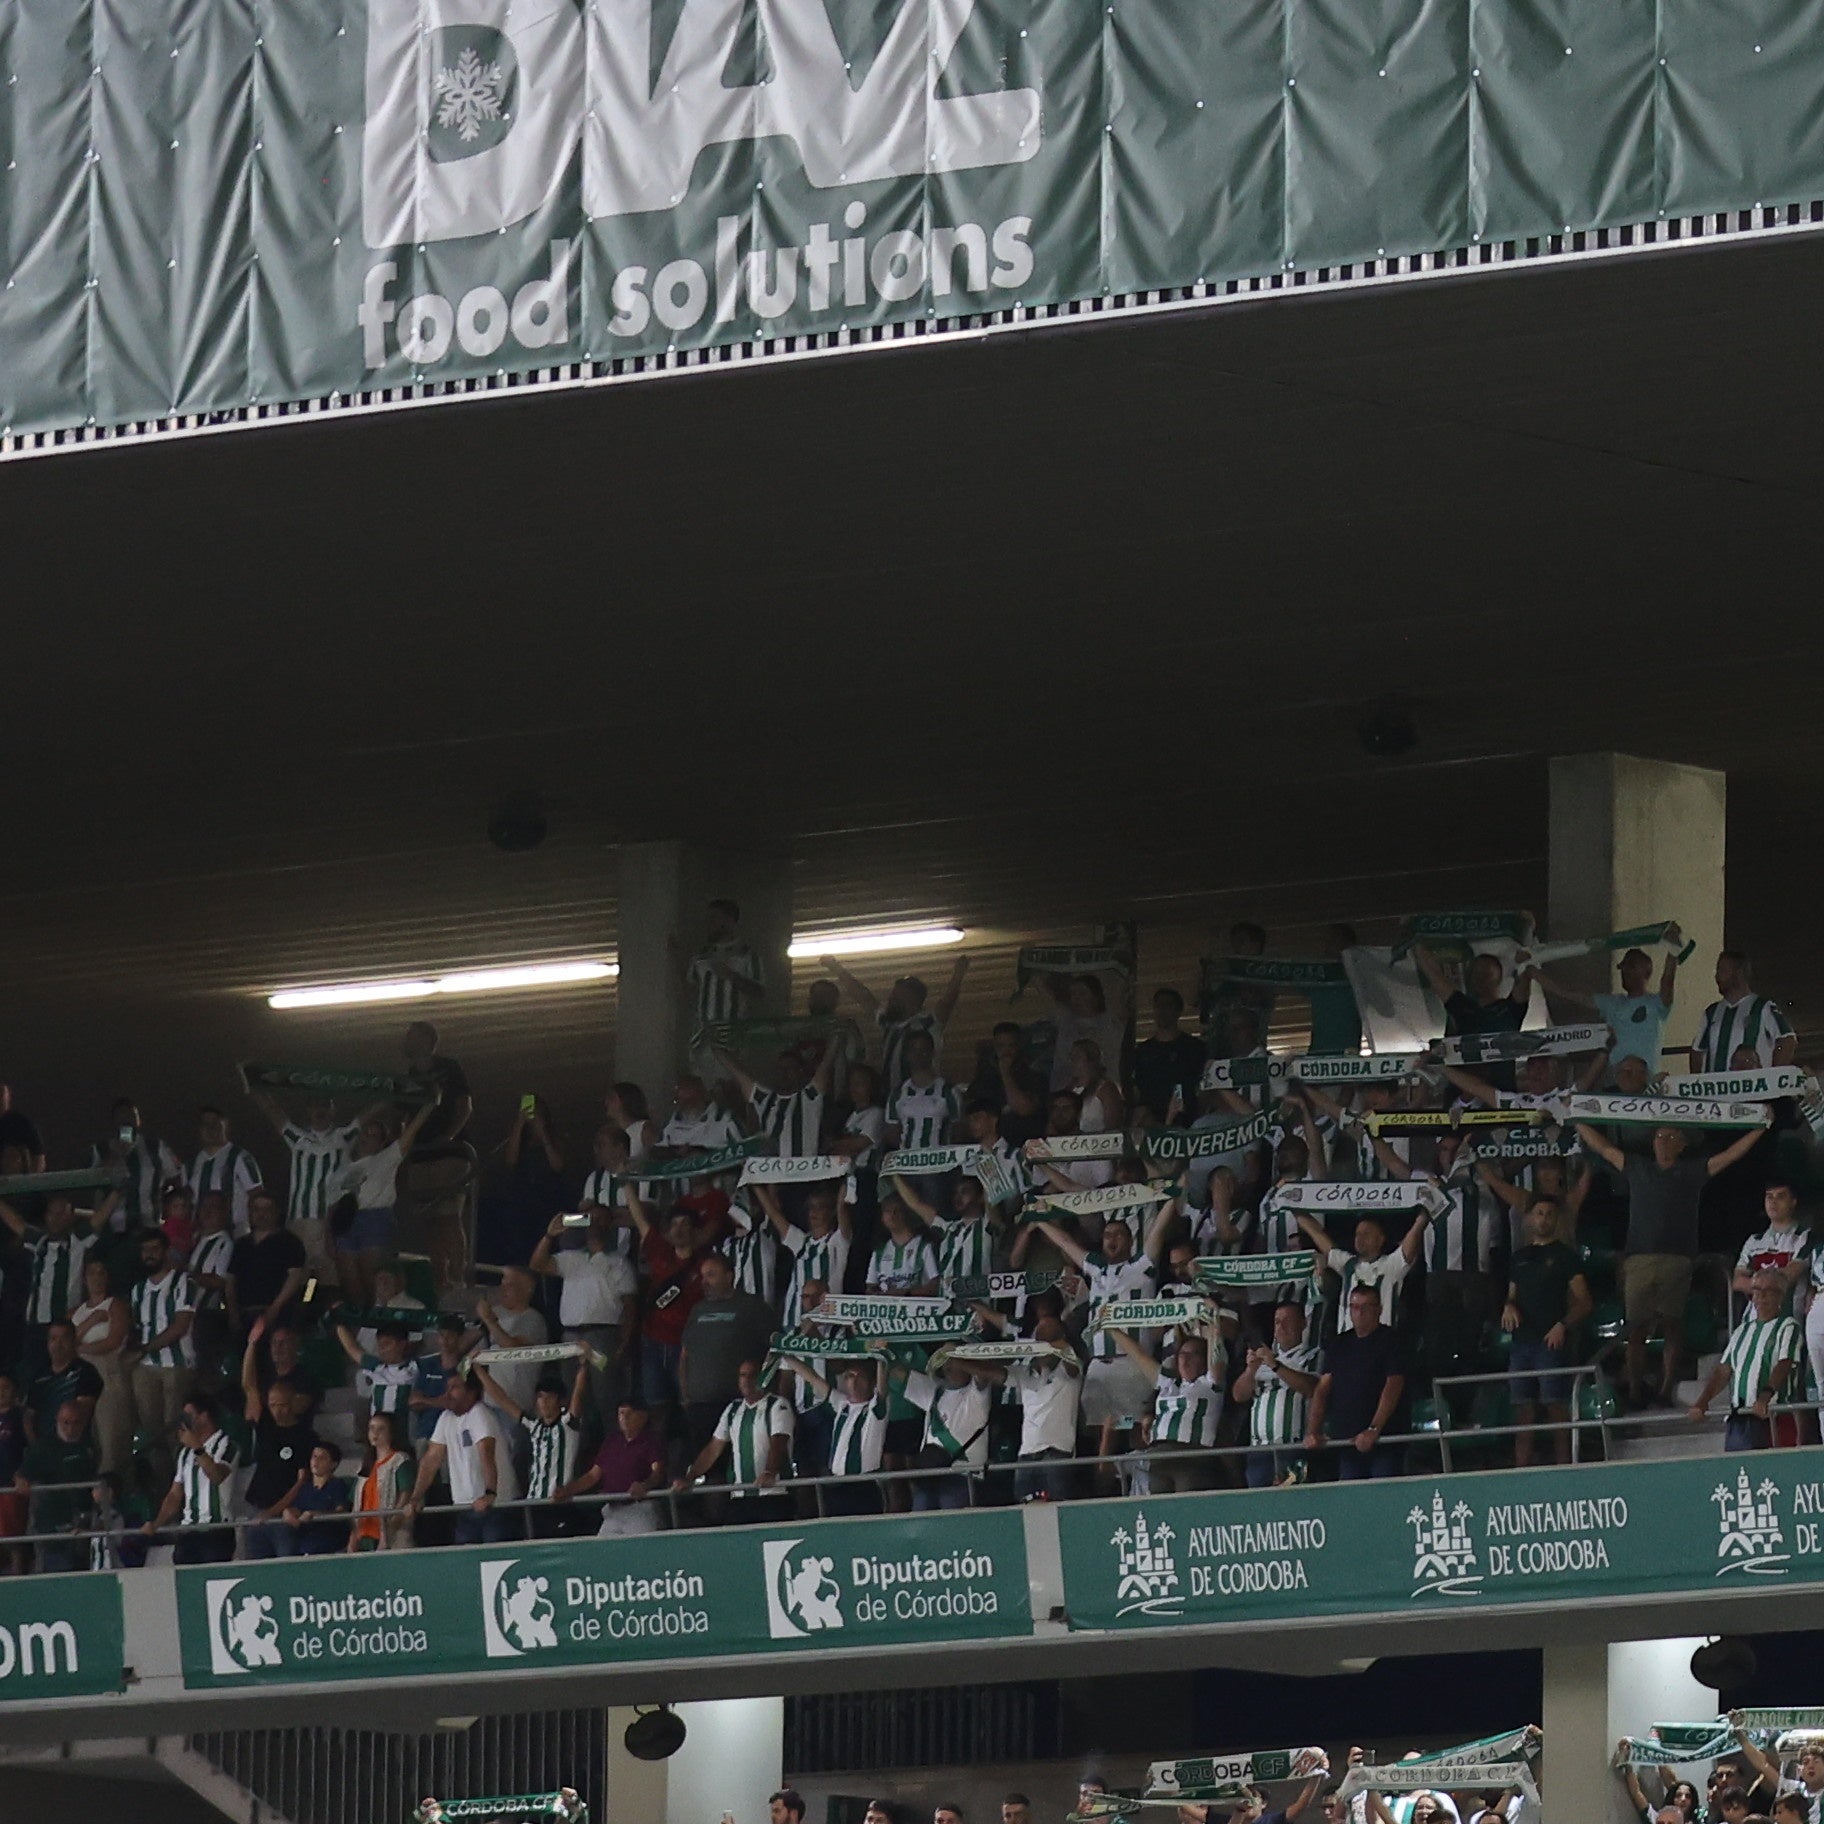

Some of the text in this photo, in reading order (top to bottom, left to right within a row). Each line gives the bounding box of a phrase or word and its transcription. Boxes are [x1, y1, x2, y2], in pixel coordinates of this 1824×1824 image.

[359, 199, 1035, 370] food solutions
[1300, 1059, 1371, 1078] CÓRDOBA
[1678, 1075, 1770, 1098] CÓRDOBA
[1314, 1184, 1404, 1203] CÓRDOBA
[942, 1314, 966, 1333] CF
[1486, 1495, 1628, 1537] AYUNTAMIENTO
[1188, 1519, 1326, 1556] AYUNTAMIENTO
[1796, 1526, 1821, 1554] DE
[852, 1549, 993, 1585] Diputación
[1490, 1539, 1609, 1575] DE CORDOBA
[566, 1570, 705, 1603] Diputación
[1191, 1561, 1308, 1595] DE CORDOBA
[290, 1592, 423, 1625] Diputación
[856, 1585, 998, 1622] de Córdoba
[570, 1606, 709, 1640] de Córdoba
[293, 1626, 428, 1659] de Córdoba
